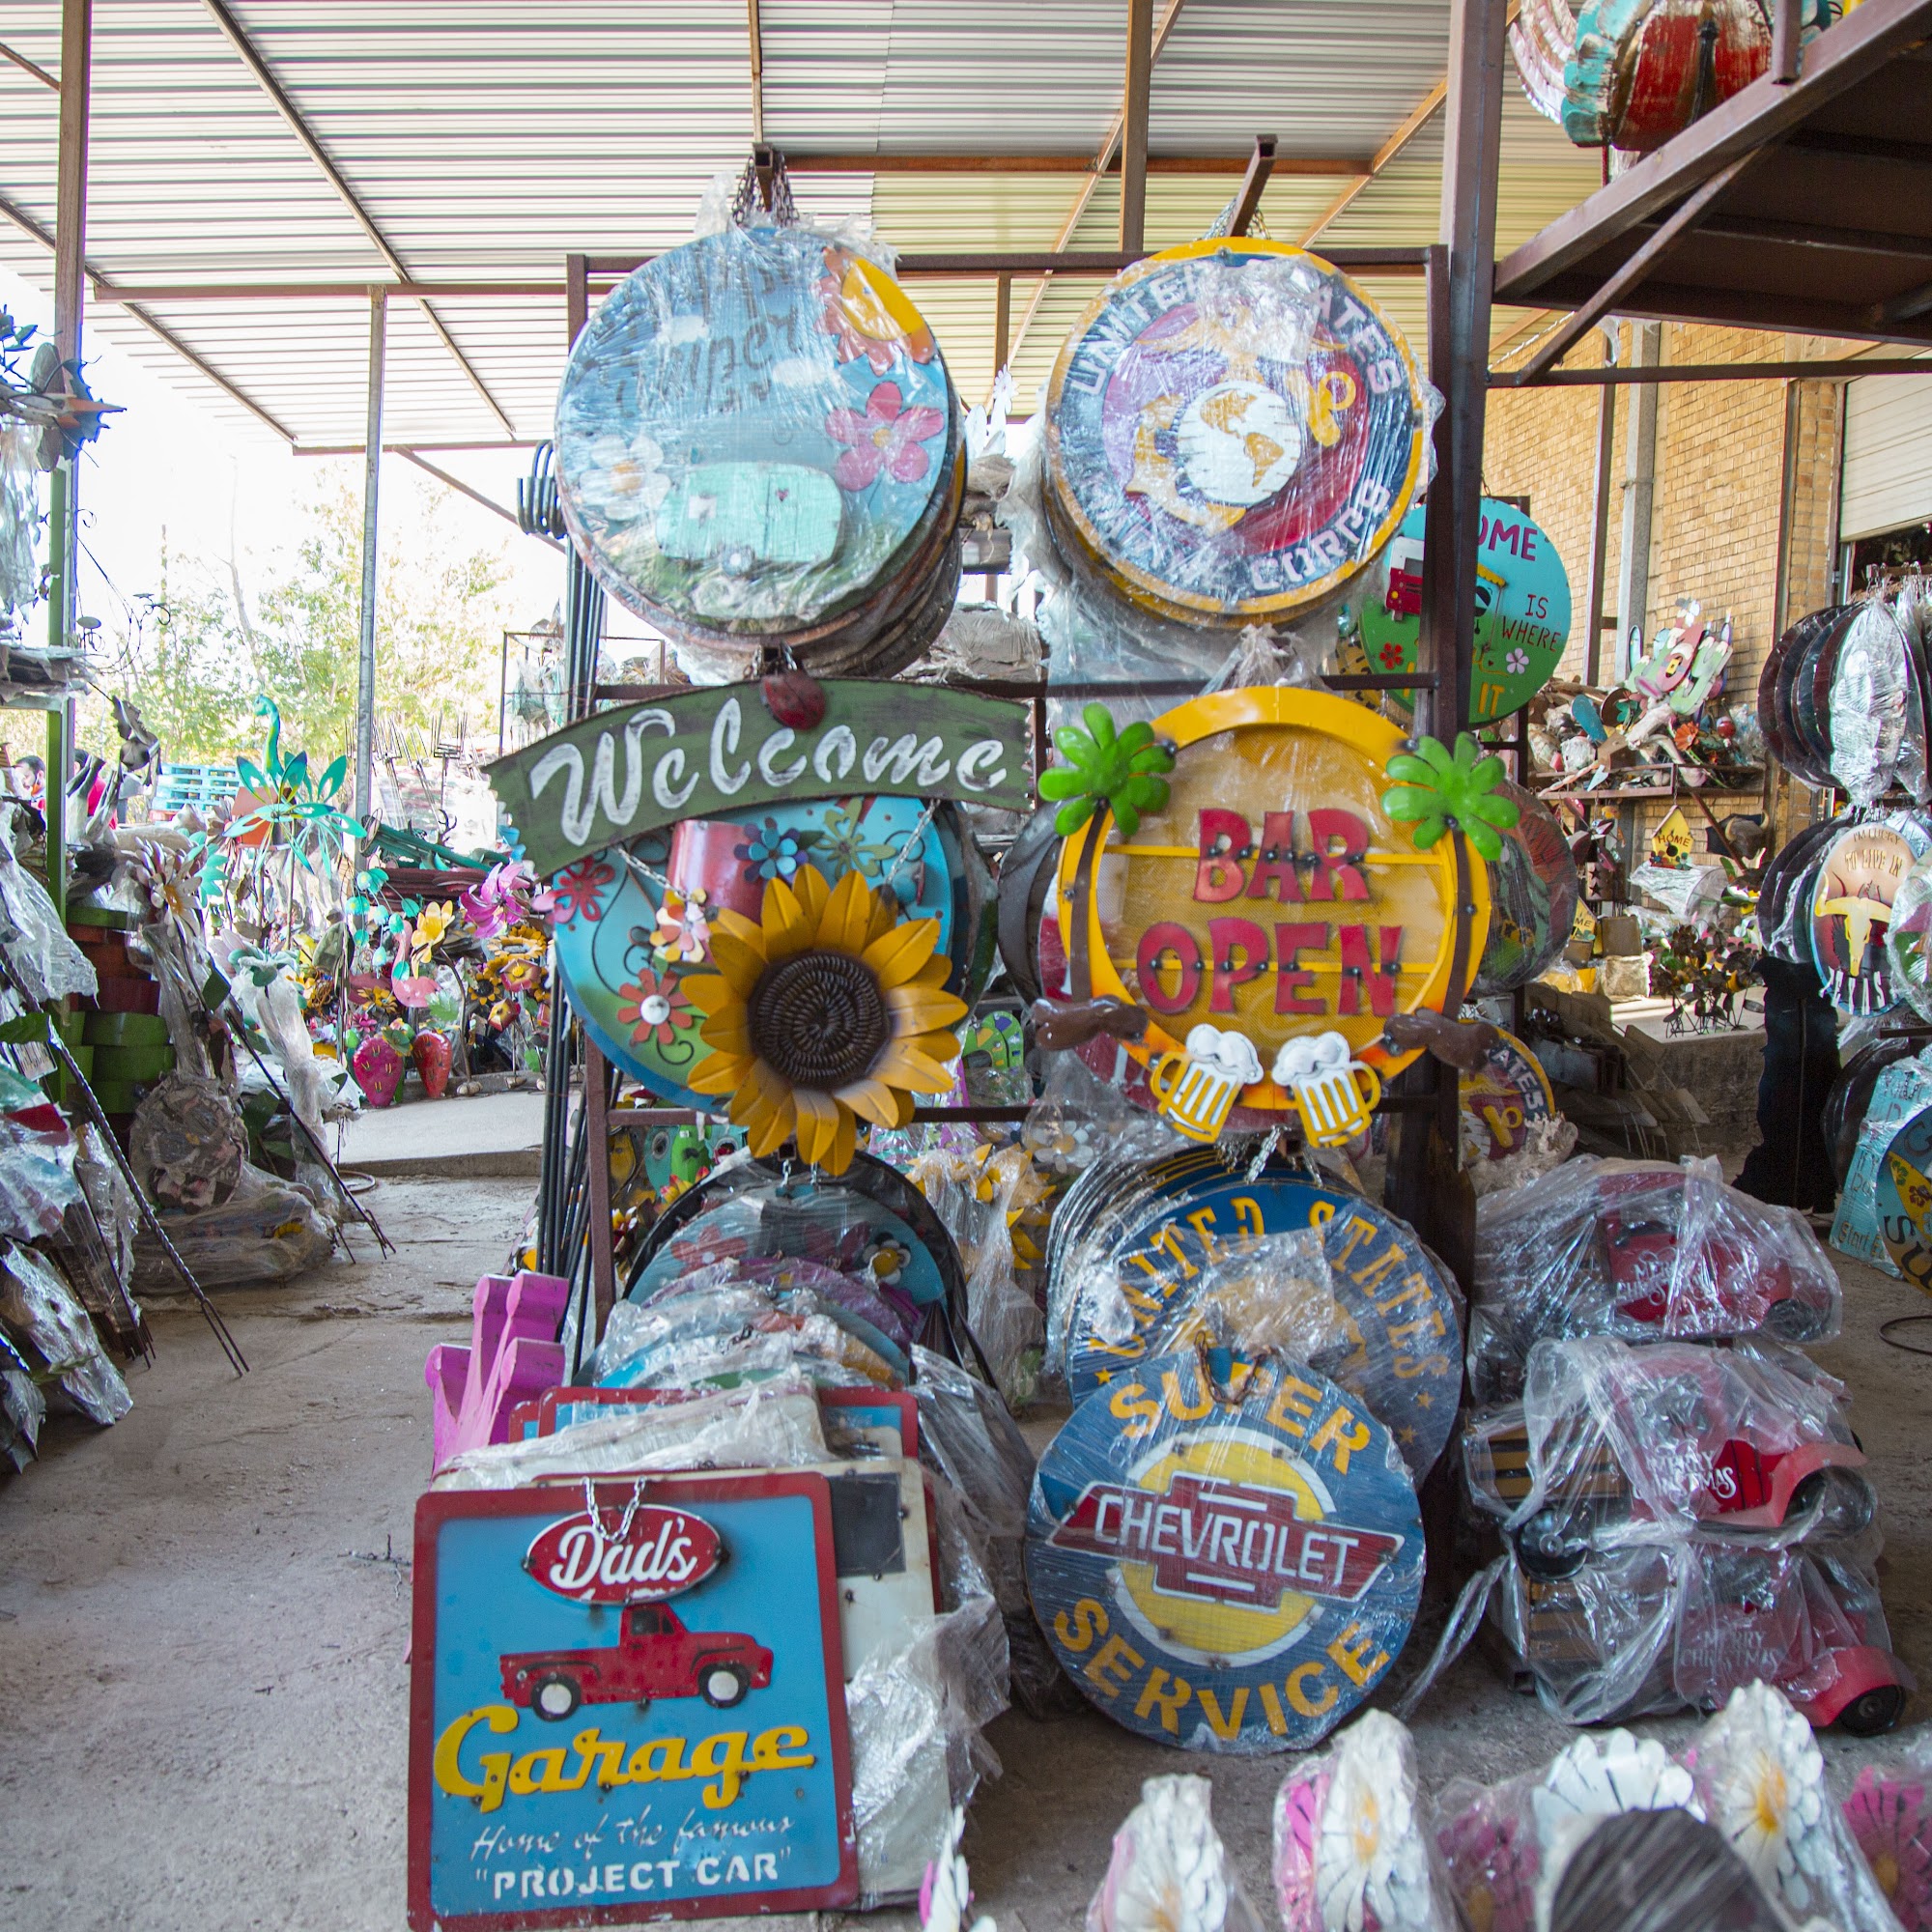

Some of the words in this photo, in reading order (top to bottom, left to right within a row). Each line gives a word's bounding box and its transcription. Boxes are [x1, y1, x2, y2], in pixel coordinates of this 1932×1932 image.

[1477, 515, 1538, 561] ME
[1502, 615, 1561, 653] WHERE
[1525, 594, 1549, 619] IS
[529, 697, 1009, 846] Welcome
[1193, 808, 1370, 903] BAR
[1658, 833, 1690, 847] HOME
[1845, 850, 1858, 872] TO
[1862, 848, 1887, 870] LIVE
[1889, 853, 1903, 878] IN
[1854, 829, 1866, 843] I'M
[1869, 828, 1900, 845] LUCKY
[1575, 917, 1592, 927] ME
[1136, 916, 1404, 1016] OPEN
[1492, 1046, 1545, 1110] ATES
[1308, 1200, 1450, 1379] STATES
[1110, 1361, 1371, 1476] SUPER
[549, 1516, 698, 1590] Dad's
[1094, 1493, 1359, 1586] CHEVROLET
[1053, 1598, 1391, 1741] SERVICE
[433, 1704, 816, 1814] Garage
[469, 1825, 563, 1862] Home
[574, 1812, 611, 1862] of
[614, 1804, 669, 1848] the
[672, 1807, 795, 1856] famous
[474, 1861, 681, 1901] "PROJECT
[696, 1845, 792, 1887] CAR"
